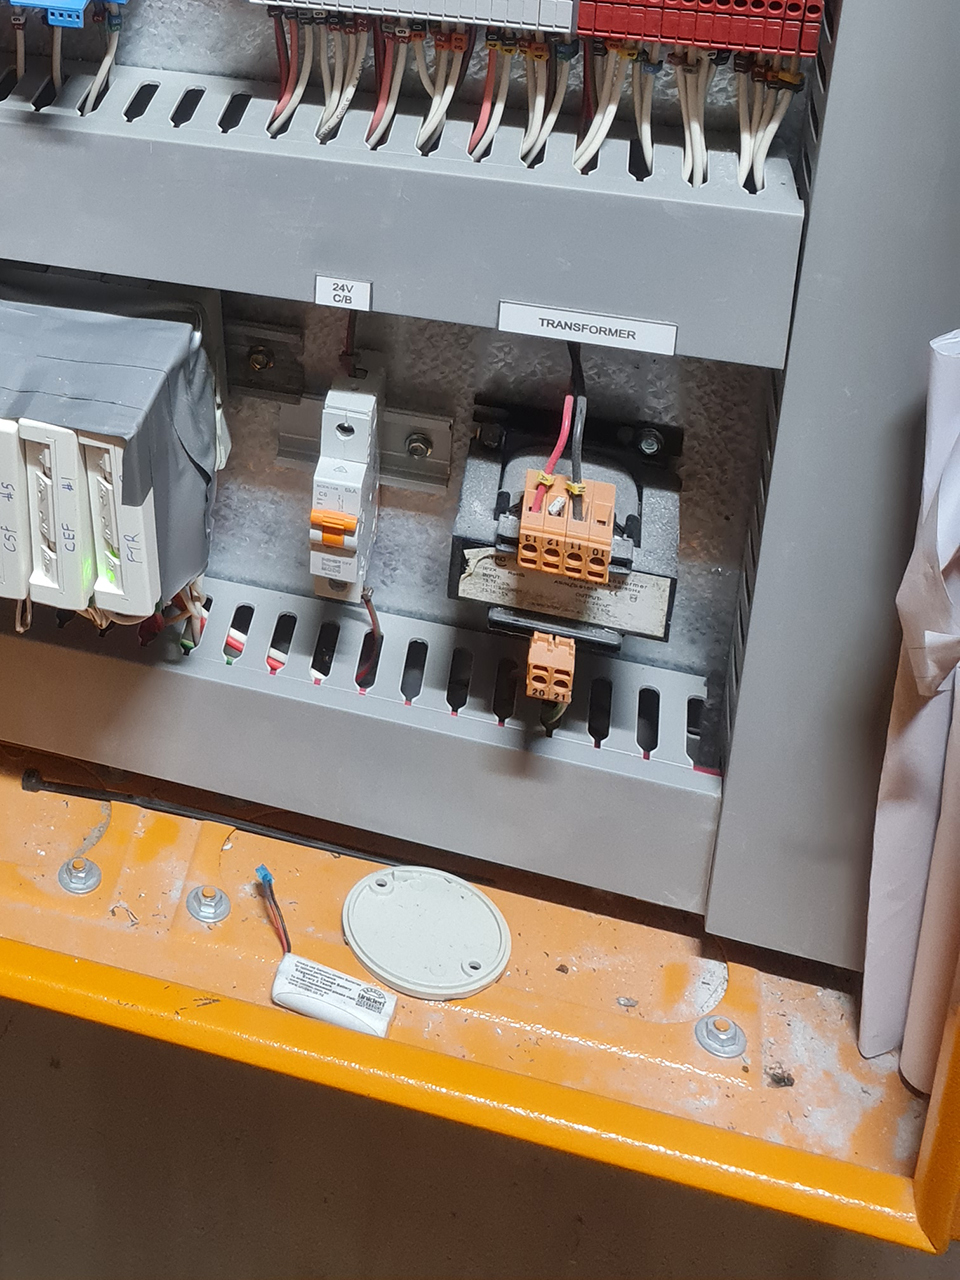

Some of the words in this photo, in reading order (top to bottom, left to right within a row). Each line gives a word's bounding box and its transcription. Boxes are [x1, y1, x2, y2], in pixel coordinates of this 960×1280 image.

[13, 17, 23, 29] 29
[315, 11, 324, 23] 19
[330, 18, 340, 30] 20
[346, 20, 354, 33] 21
[358, 18, 368, 32] 22
[398, 29, 408, 42] 29
[488, 35, 497, 48] 40
[454, 37, 463, 51] 33
[505, 41, 514, 54] 41
[332, 282, 354, 294] 24V
[332, 294, 352, 305] C/B
[539, 317, 637, 341] TRANSFORMER
[60, 476, 74, 492] #1
[0, 525, 18, 553] CSF
[61, 522, 76, 553] CEF
[525, 534, 536, 543] 13
[124, 532, 143, 564] FTR
[570, 542, 581, 550] 11
[592, 548, 605, 557] 10
[532, 688, 545, 697] 20
[320, 976, 336, 985] Change
[337, 982, 352, 991] Battery
[358, 992, 386, 1007] Uniden
